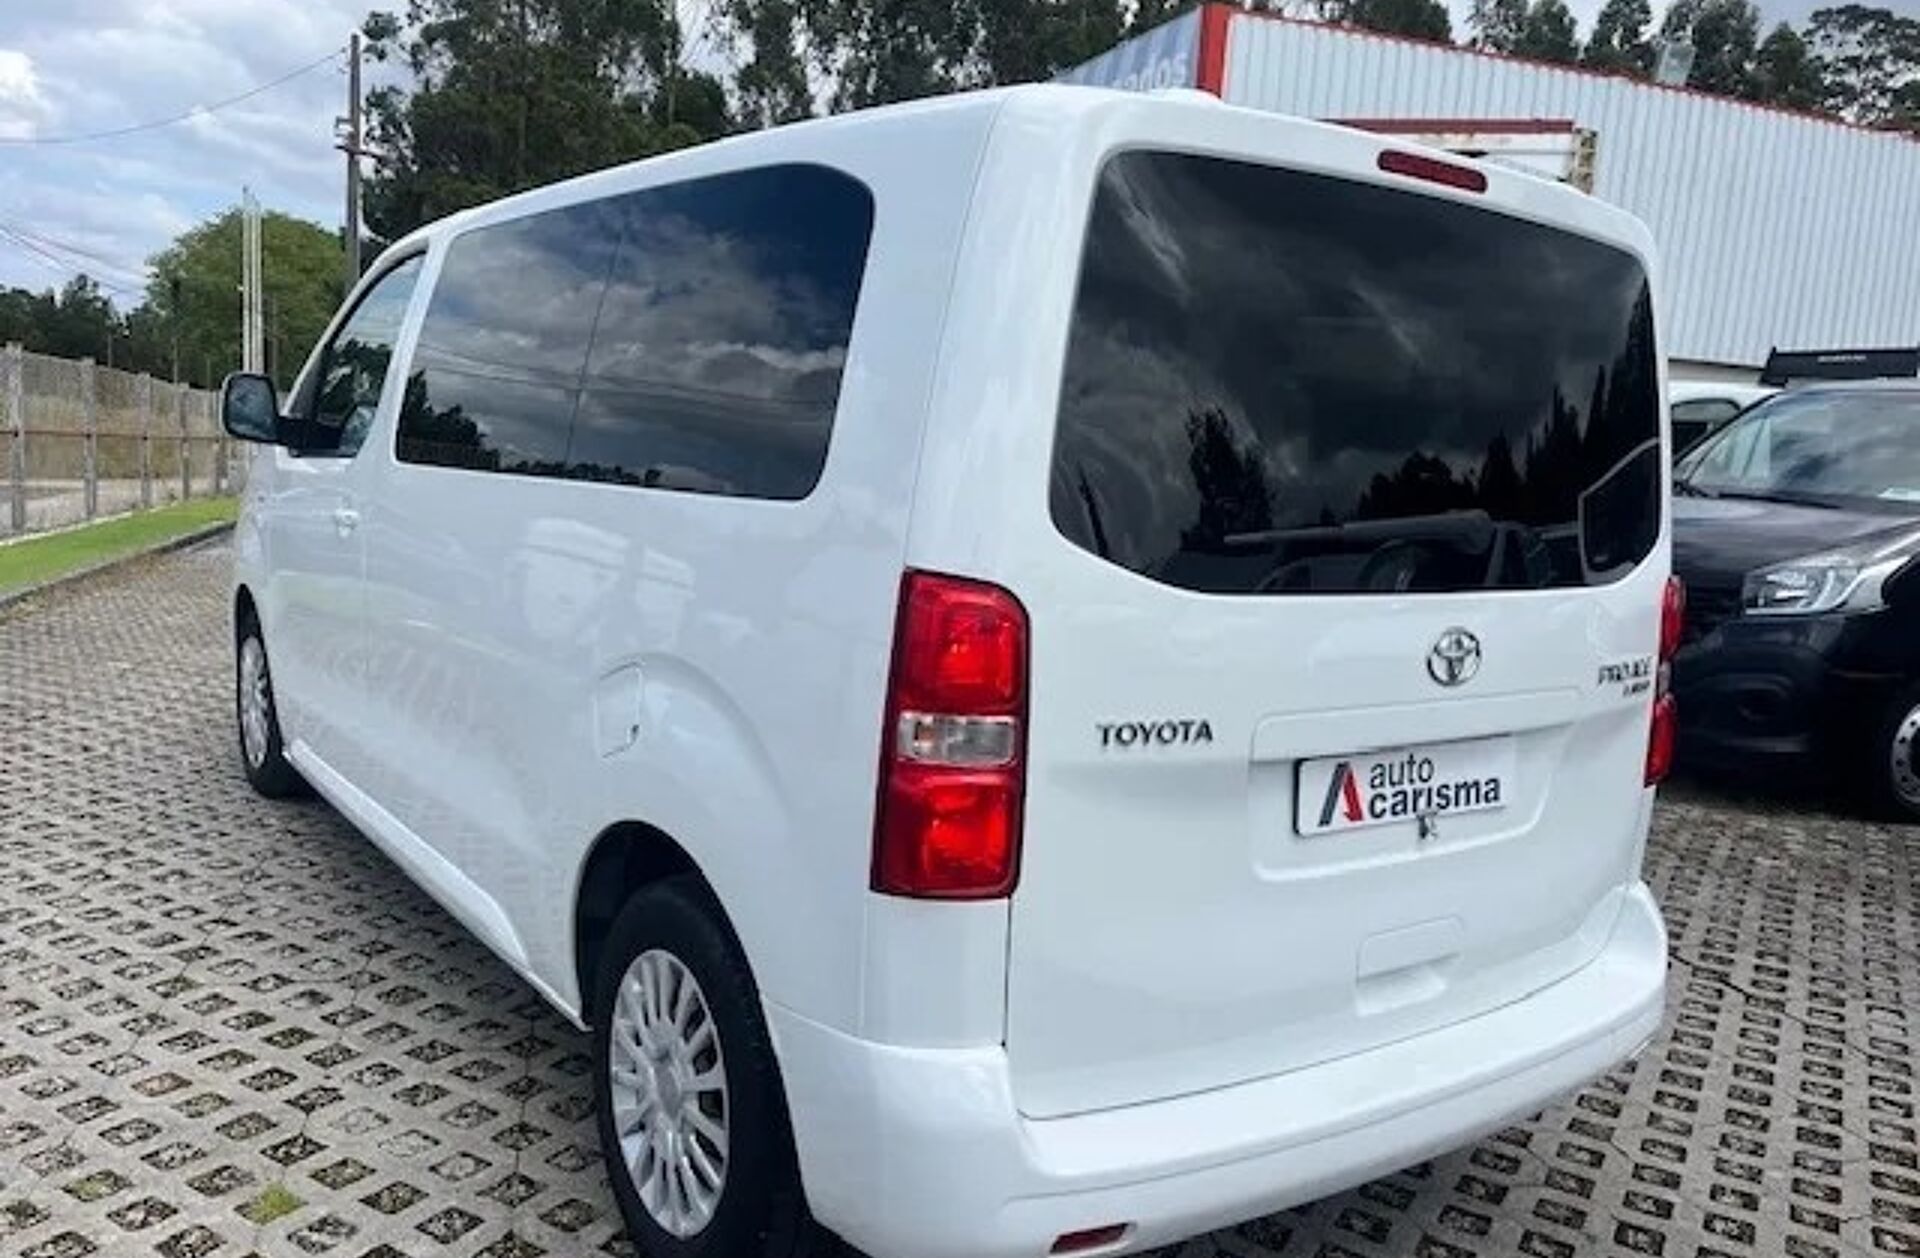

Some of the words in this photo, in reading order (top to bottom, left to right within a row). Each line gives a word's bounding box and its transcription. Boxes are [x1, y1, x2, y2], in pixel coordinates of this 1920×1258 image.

[1095, 720, 1213, 747] TOYOTA
[1370, 753, 1435, 789] auto
[1368, 777, 1500, 819] carisma
